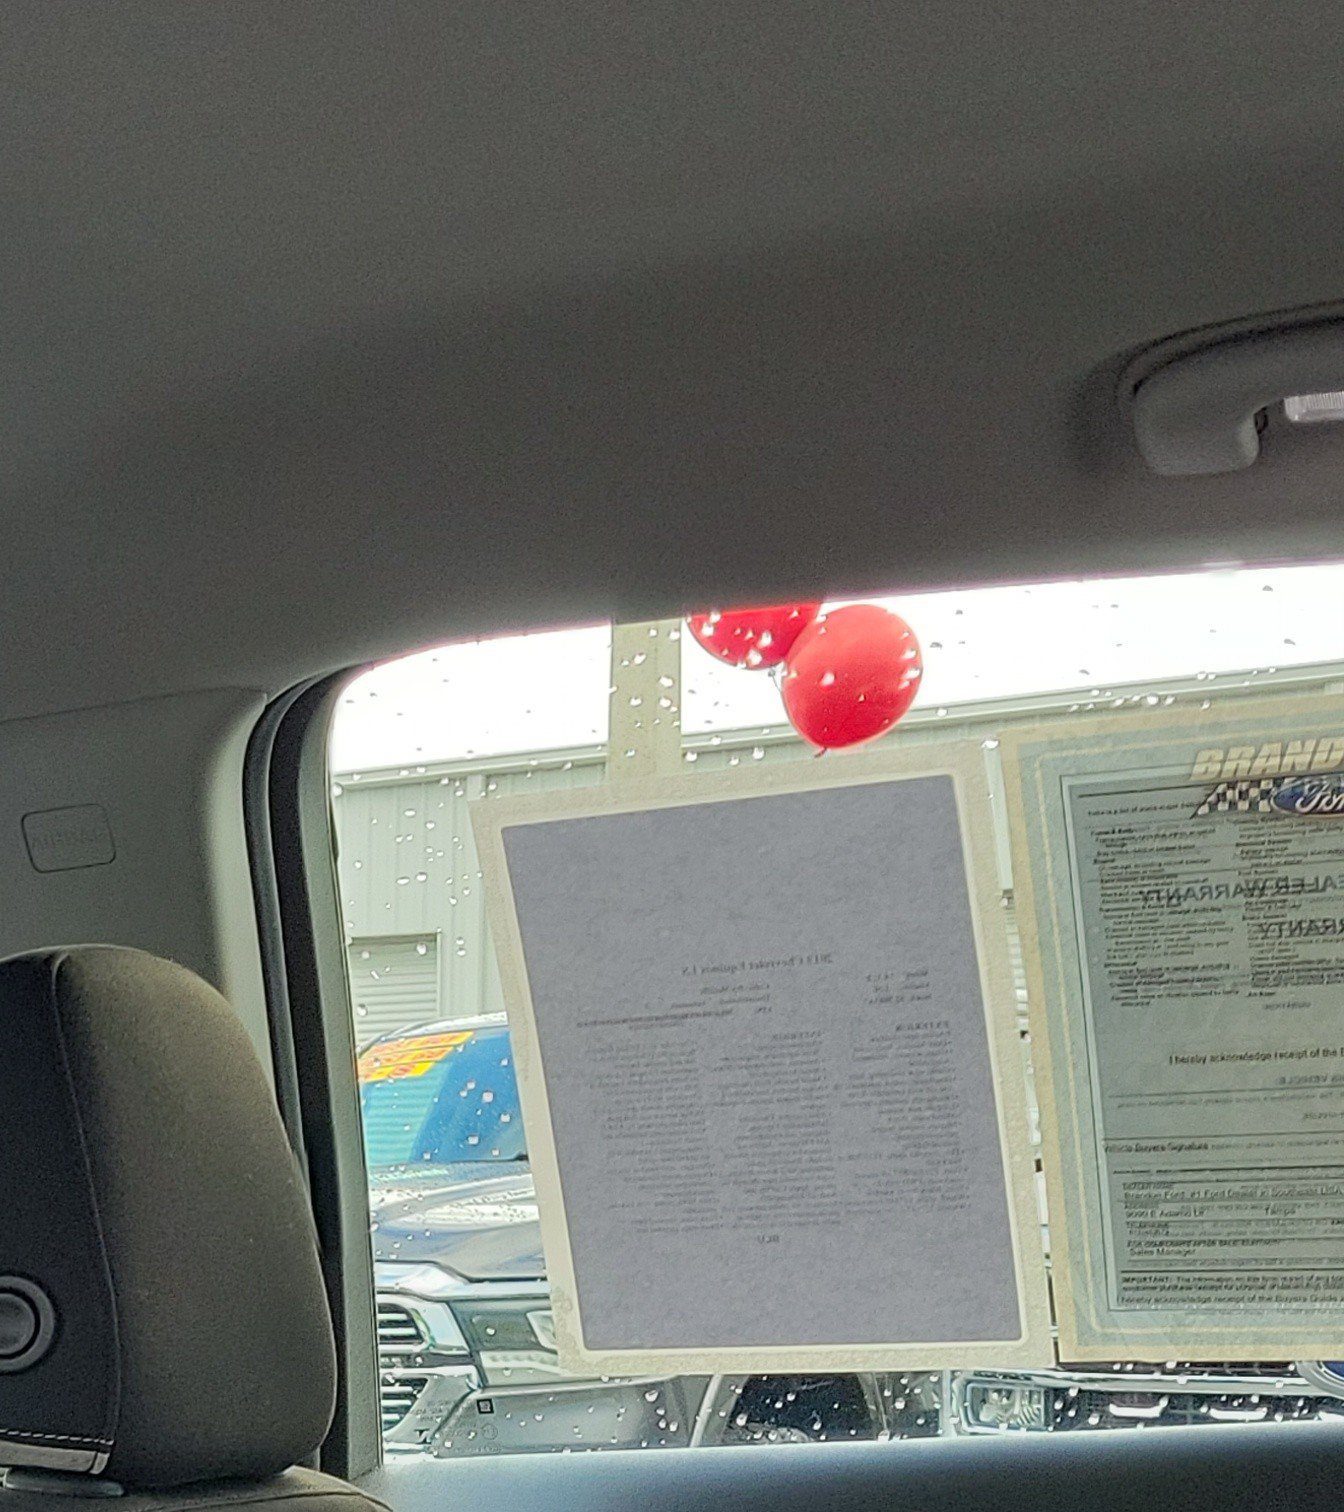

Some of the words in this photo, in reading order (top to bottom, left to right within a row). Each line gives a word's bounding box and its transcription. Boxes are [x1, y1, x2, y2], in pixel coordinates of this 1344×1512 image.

[1175, 1054, 1207, 1065] hereby
[1210, 1051, 1272, 1063] acknowledge
[1275, 1049, 1309, 1060] receipt
[1310, 1048, 1320, 1058] of
